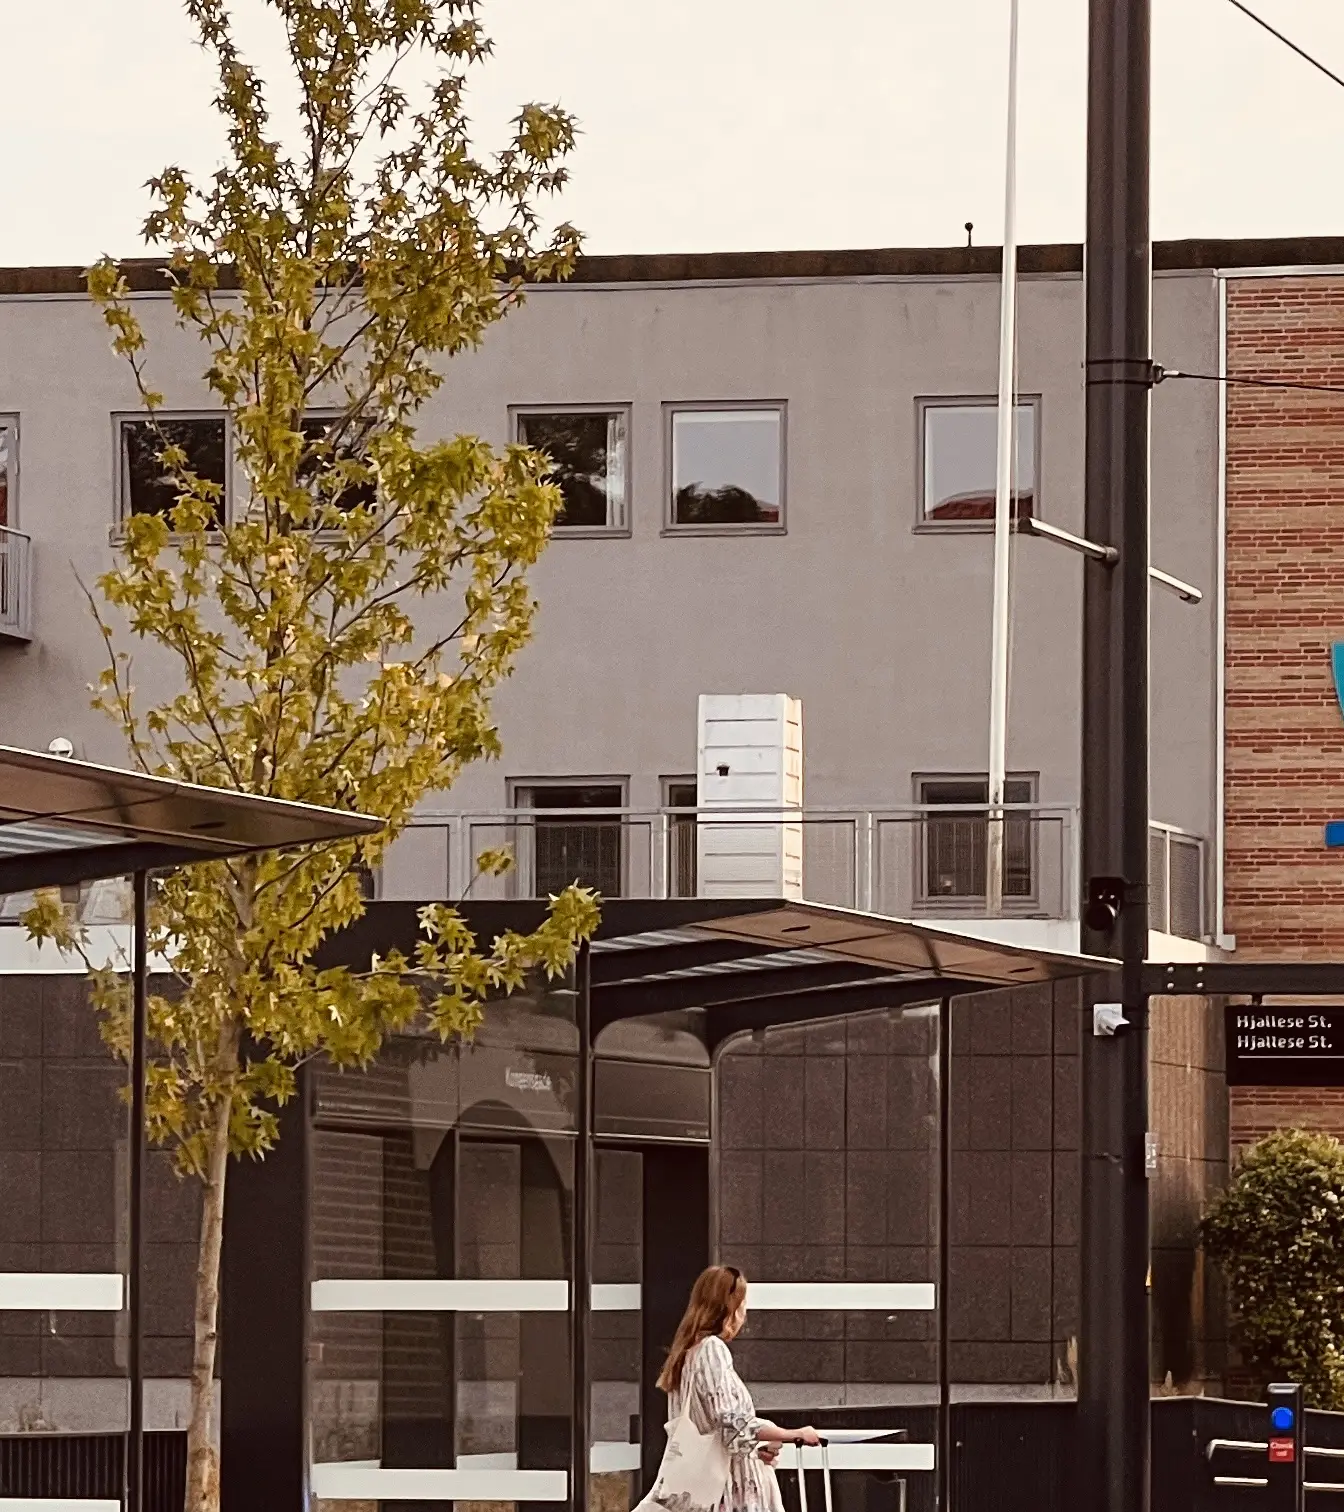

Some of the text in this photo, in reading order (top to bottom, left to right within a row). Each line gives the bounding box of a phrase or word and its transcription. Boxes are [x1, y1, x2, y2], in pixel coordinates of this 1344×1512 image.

[1236, 1014, 1332, 1030] Hjallese St.
[1237, 1035, 1305, 1051] Hjallese
[1308, 1035, 1333, 1049] St.
